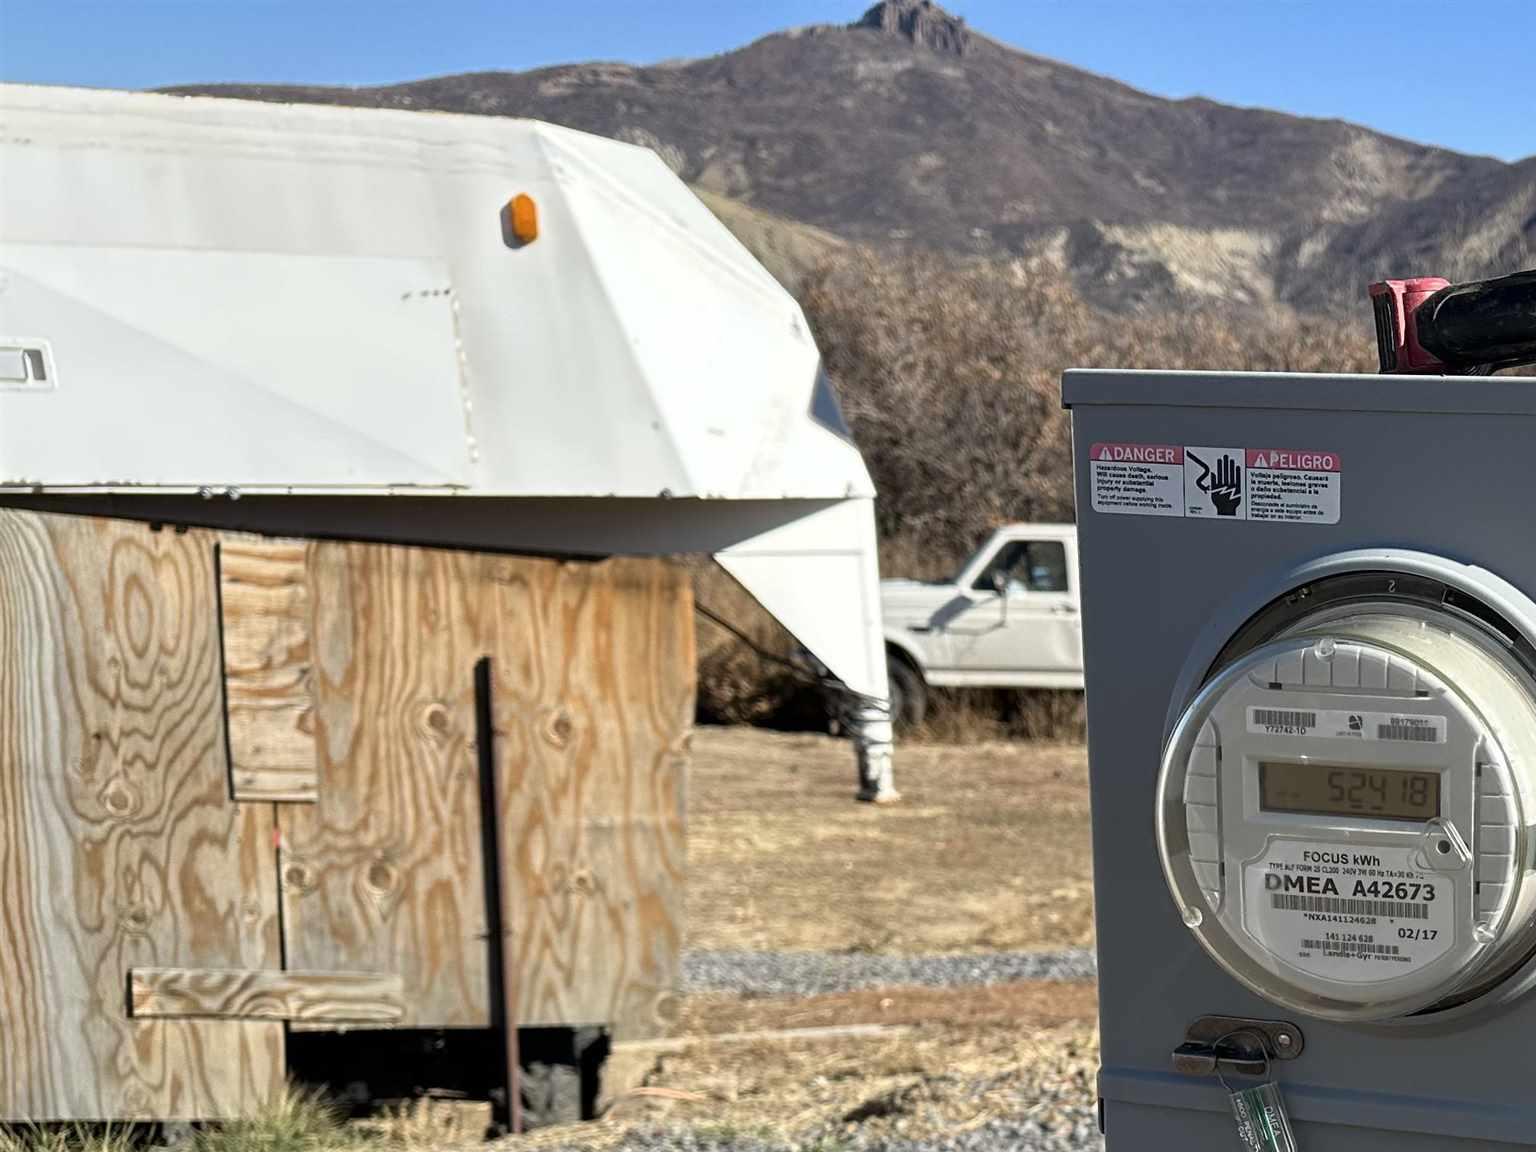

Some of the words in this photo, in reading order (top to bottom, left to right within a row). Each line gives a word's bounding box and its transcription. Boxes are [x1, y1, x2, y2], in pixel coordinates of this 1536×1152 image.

[1114, 447, 1175, 463] DANGER
[1270, 453, 1334, 471] PELIGRO
[1327, 772, 1429, 807] 52418
[1303, 851, 1349, 865] FOCUS
[1353, 853, 1381, 867] kWh
[1264, 873, 1339, 896] DMEA
[1353, 879, 1436, 901] A42673
[1397, 927, 1438, 942] 02/17
